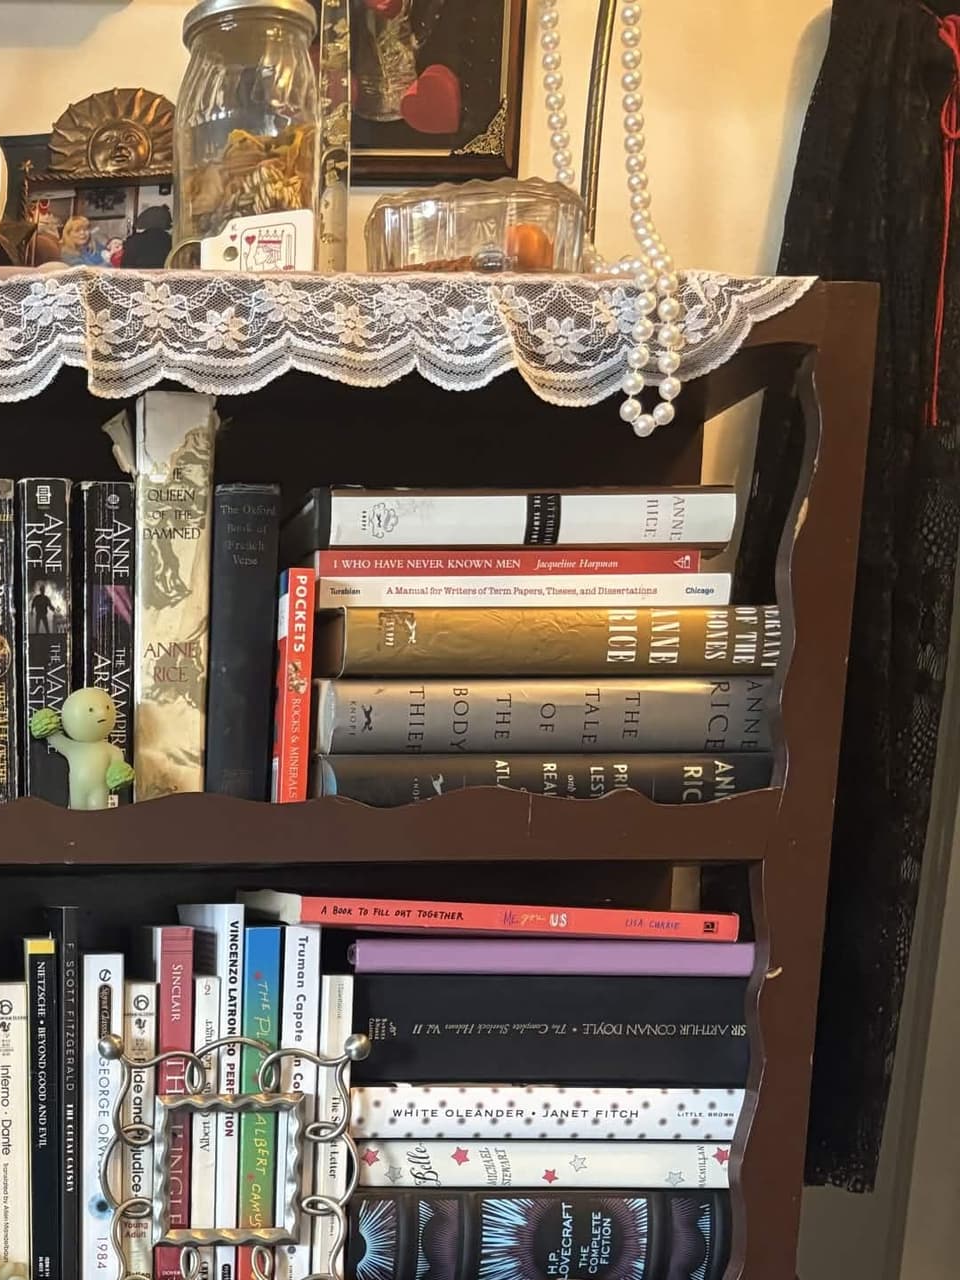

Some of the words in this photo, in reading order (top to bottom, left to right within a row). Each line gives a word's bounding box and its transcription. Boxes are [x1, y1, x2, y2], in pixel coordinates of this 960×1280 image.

[147, 488, 196, 502] QUEEN
[25, 523, 43, 568] RICE
[44, 513, 64, 573] ANNE
[94, 527, 114, 573] RICE
[111, 519, 132, 577] ANNE
[142, 527, 201, 541] DAMNED
[342, 559, 371, 569] WHO
[374, 560, 404, 568] HAVE
[407, 560, 444, 568] NEVER
[448, 560, 492, 568] KNOWN
[496, 560, 521, 568] MEN
[534, 559, 576, 570] Jacqueline
[579, 559, 618, 570] Harpman
[294, 575, 307, 653] POCKETS
[329, 587, 361, 595] Turabian
[685, 587, 714, 595] Chicago
[143, 642, 199, 659] ANNE
[606, 608, 638, 664] RICE
[648, 608, 681, 665] ANNE
[152, 666, 189, 683] RICE
[407, 686, 426, 754] THIEF
[449, 686, 469, 753] BODY
[494, 694, 512, 741] THE
[538, 702, 558, 735] OF
[581, 688, 600, 747] TALE
[621, 692, 641, 741] THE
[706, 680, 730, 753] RICE
[741, 679, 762, 753] ANNE
[549, 912, 568, 928] US
[297, 936, 309, 988] Truman
[171, 964, 182, 1022] SINCLAIR
[293, 994, 306, 1042] Capote
[0, 1064, 11, 1108] Inferno
[0, 1119, 11, 1155] Dante
[392, 1109, 439, 1119] WHITE
[445, 1109, 525, 1118] OLEANDER
[541, 1109, 589, 1119] JANET
[595, 1109, 640, 1119] FITCH
[96, 1237, 109, 1270] 1984
[588, 1210, 602, 1274] COMPLETE
[600, 1217, 613, 1265] FICTION
